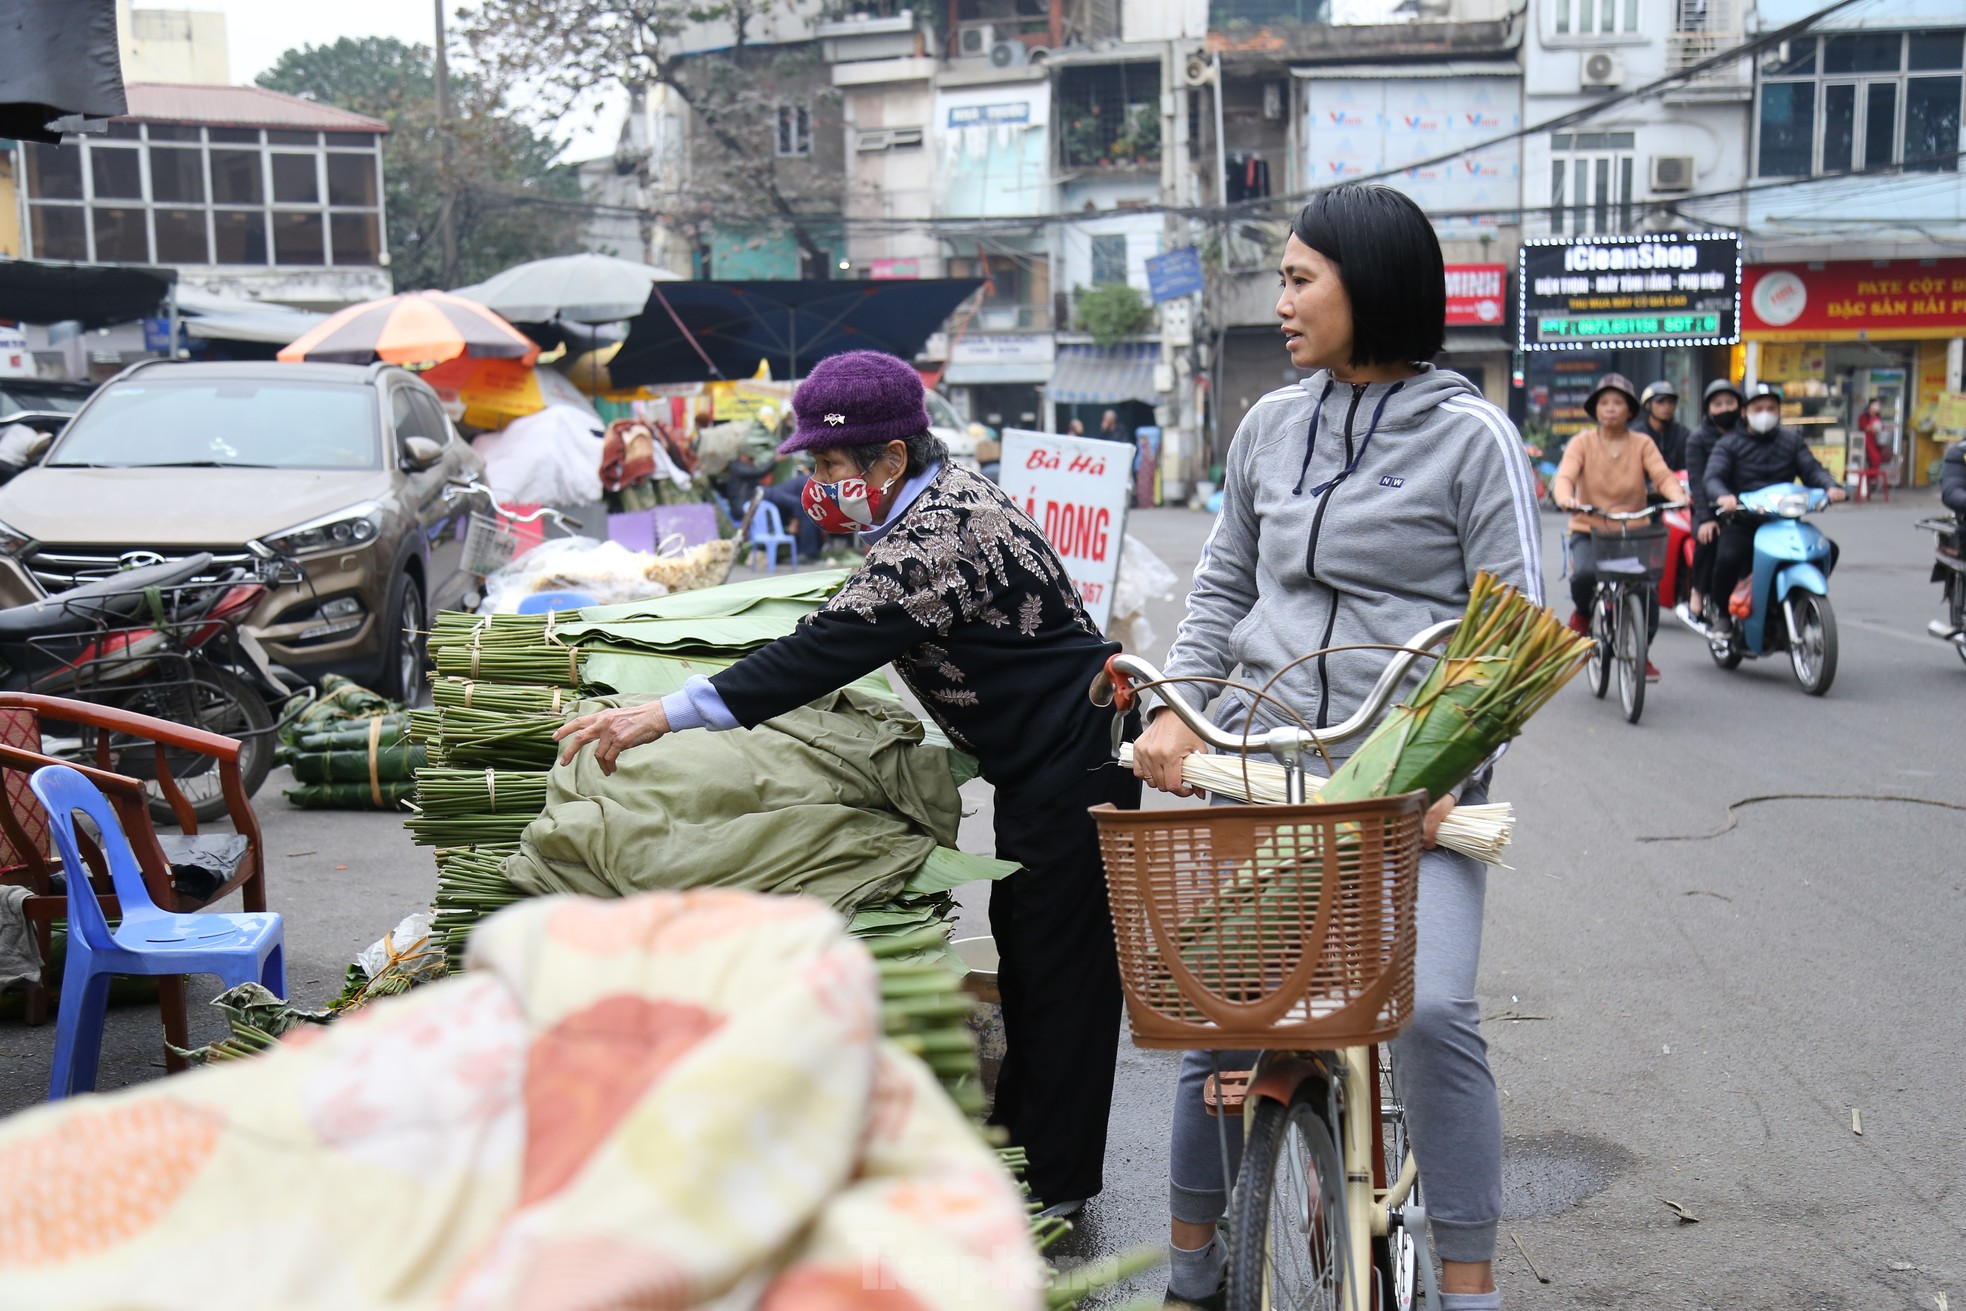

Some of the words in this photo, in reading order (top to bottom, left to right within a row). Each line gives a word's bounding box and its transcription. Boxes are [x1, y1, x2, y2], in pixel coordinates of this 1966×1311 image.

[1564, 243, 1698, 271] iCleanShop
[1858, 280, 1903, 296] PATE
[1044, 500, 1110, 562] DONG
